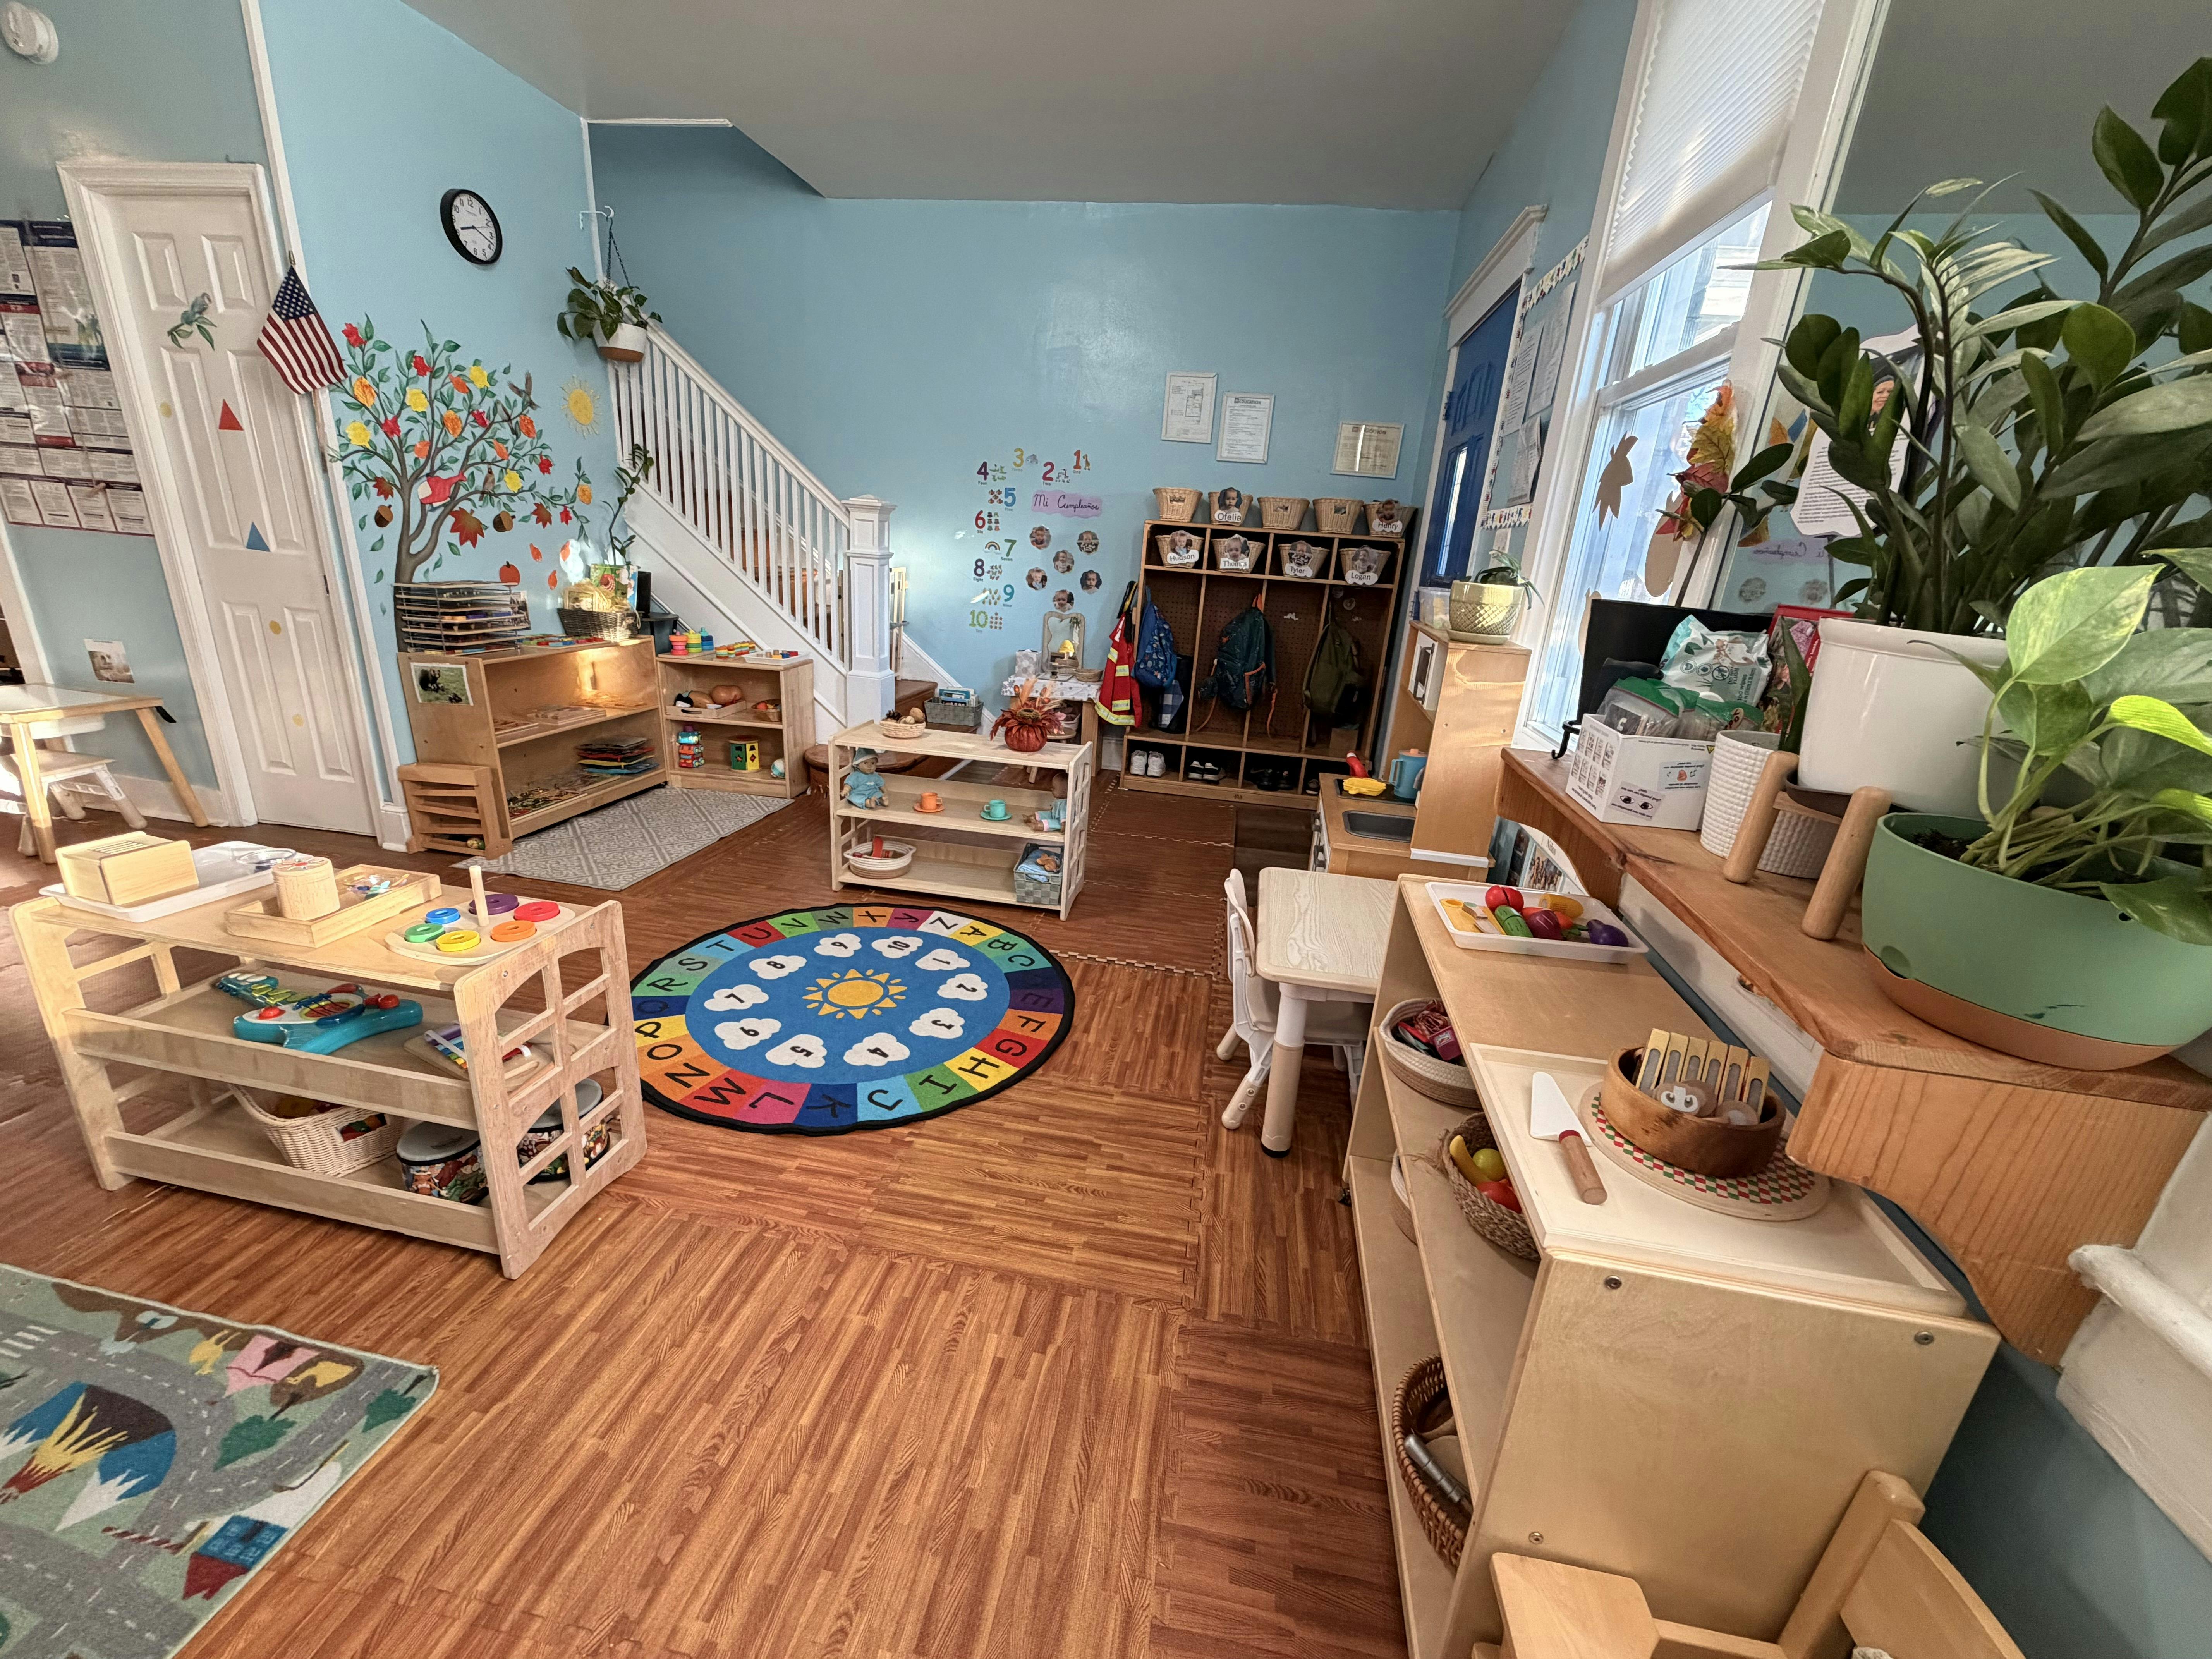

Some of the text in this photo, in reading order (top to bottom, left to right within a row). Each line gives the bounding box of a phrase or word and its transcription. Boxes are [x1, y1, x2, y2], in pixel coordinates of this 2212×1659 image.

[460, 198, 464, 206] 11
[467, 198, 473, 208] 12
[486, 219, 491, 227] 2
[1013, 448, 1024, 467] 3
[1073, 450, 1082, 469] 1
[977, 461, 989, 480] 4
[1042, 462, 1054, 481] 2
[1004, 488, 1016, 507] 5
[1034, 494, 1100, 512] Mi Cumpleaños
[975, 510, 986, 529] 6
[1217, 513, 1241, 521] Ofelia
[1004, 539, 1017, 557] 7
[974, 558, 984, 577] 8
[1291, 566, 1305, 574] Tyler
[1351, 572, 1371, 581] Logan
[1003, 584, 1014, 602] 9
[969, 610, 988, 628] 10
[780, 918, 809, 927] V
[818, 911, 849, 924] W
[858, 910, 886, 922] X
[929, 917, 958, 930] Z
[742, 927, 771, 939] U
[960, 926, 987, 936] A
[706, 940, 735, 951] T
[831, 941, 848, 950] 9
[887, 940, 910, 951] 10
[988, 939, 1017, 951] B
[678, 958, 708, 971] S
[766, 961, 785, 969] 8
[1008, 955, 1035, 967] C
[647, 978, 688, 991] R
[955, 983, 977, 992] 2
[725, 993, 745, 1003] 7
[635, 1022, 661, 1038] P
[931, 1020, 955, 1030] 3
[1017, 1015, 1046, 1032] F
[739, 1026, 760, 1037] 6
[647, 1044, 682, 1060] O
[790, 1046, 814, 1058] 5
[867, 1047, 889, 1058] 4
[995, 1039, 1027, 1056] G
[958, 1056, 1000, 1079] H
[664, 1063, 710, 1088] N
[694, 1078, 746, 1105] M
[919, 1075, 957, 1095] I
[749, 1092, 794, 1109] L
[806, 1094, 852, 1118] K
[867, 1089, 903, 1111] J
